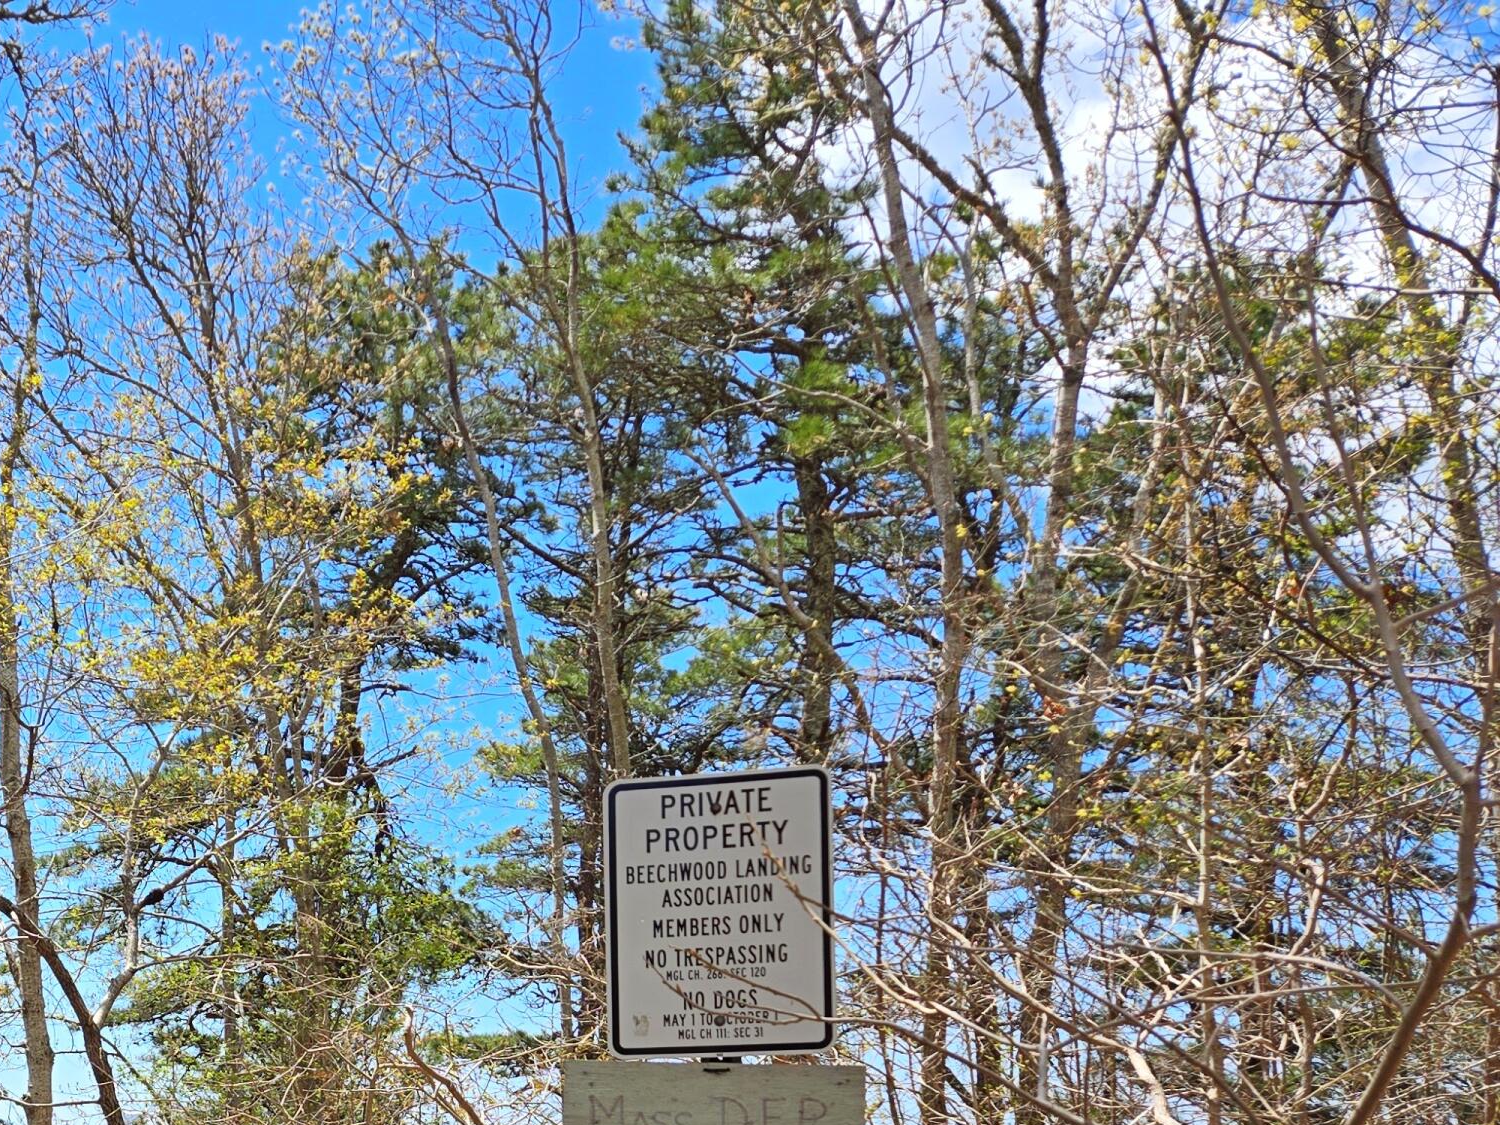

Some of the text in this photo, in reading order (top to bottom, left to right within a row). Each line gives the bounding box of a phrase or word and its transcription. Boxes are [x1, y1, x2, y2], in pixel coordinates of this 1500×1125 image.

[661, 787, 773, 819] PRIVATE
[646, 820, 788, 853] PROPERTY
[626, 855, 812, 884] BEECHWOOD LANDING
[662, 883, 773, 908] ASSOCIATION
[653, 913, 785, 938] MEMBERS ONLY
[645, 944, 788, 968] NO TRESPASSING
[666, 969, 684, 981] MGL
[750, 966, 766, 978] 120
[683, 989, 758, 1011] NO DOGS
[663, 1014, 686, 1028] MAY
[691, 1014, 696, 1026] 1
[699, 1013, 713, 1026] TO
[719, 1010, 770, 1026] CTOBER
[678, 1029, 696, 1041] MGL
[699, 1028, 712, 1040] CH
[733, 1027, 752, 1039] SEC
[754, 1026, 764, 1038] 31
